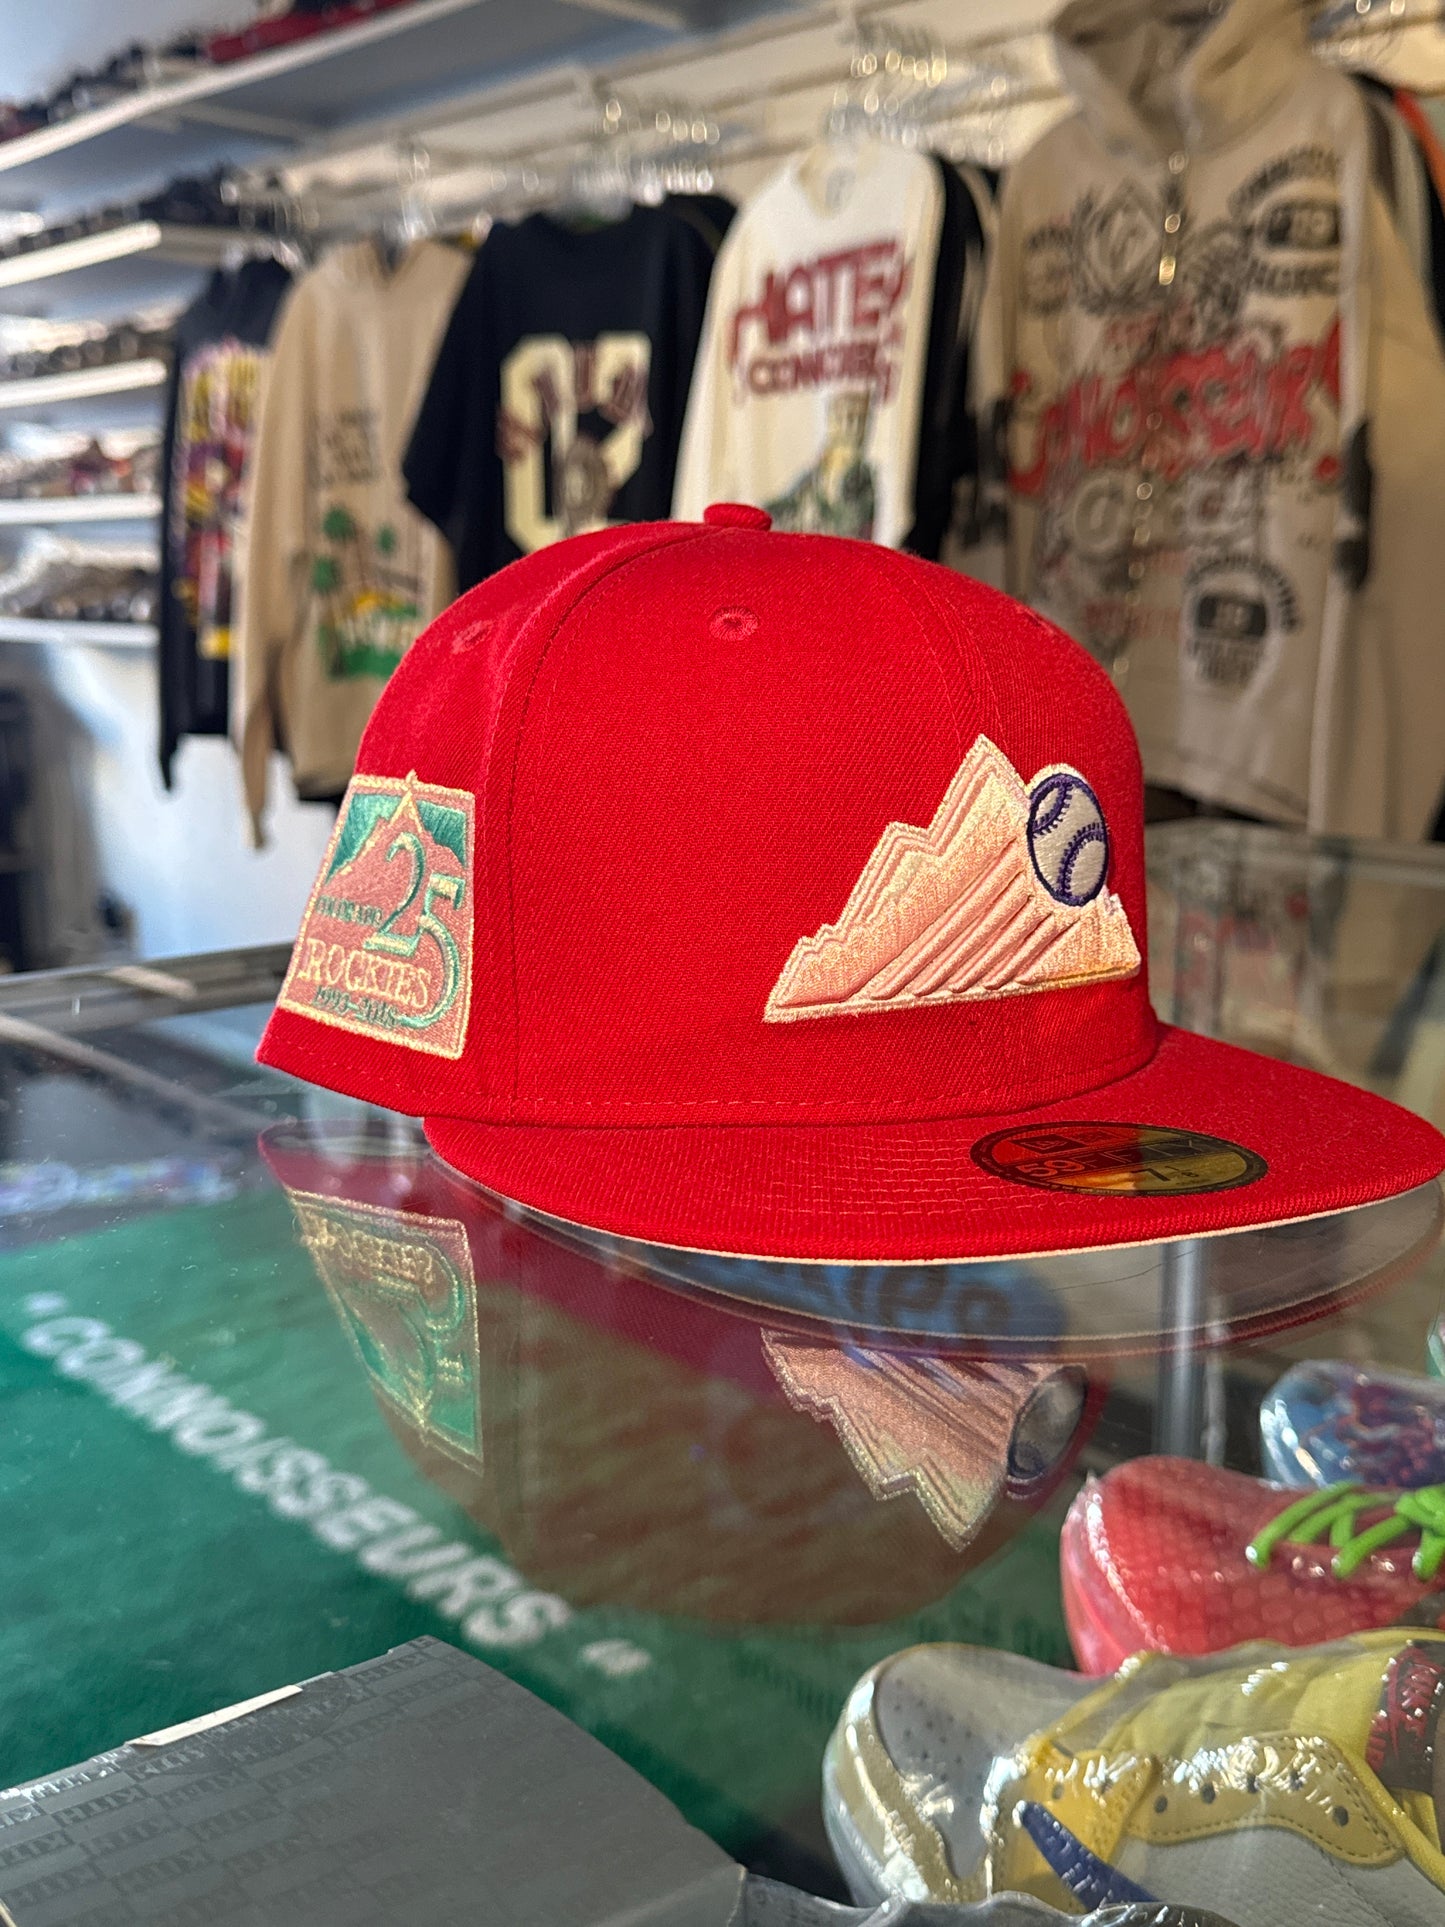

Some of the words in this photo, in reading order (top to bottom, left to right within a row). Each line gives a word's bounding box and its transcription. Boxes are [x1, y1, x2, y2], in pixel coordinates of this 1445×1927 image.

[297, 937, 431, 1009] ROCKIES
[363, 832, 466, 1029] 25
[23, 1316, 571, 1648] CONNOISSEURS
[55, 1785, 145, 1826] KITH
